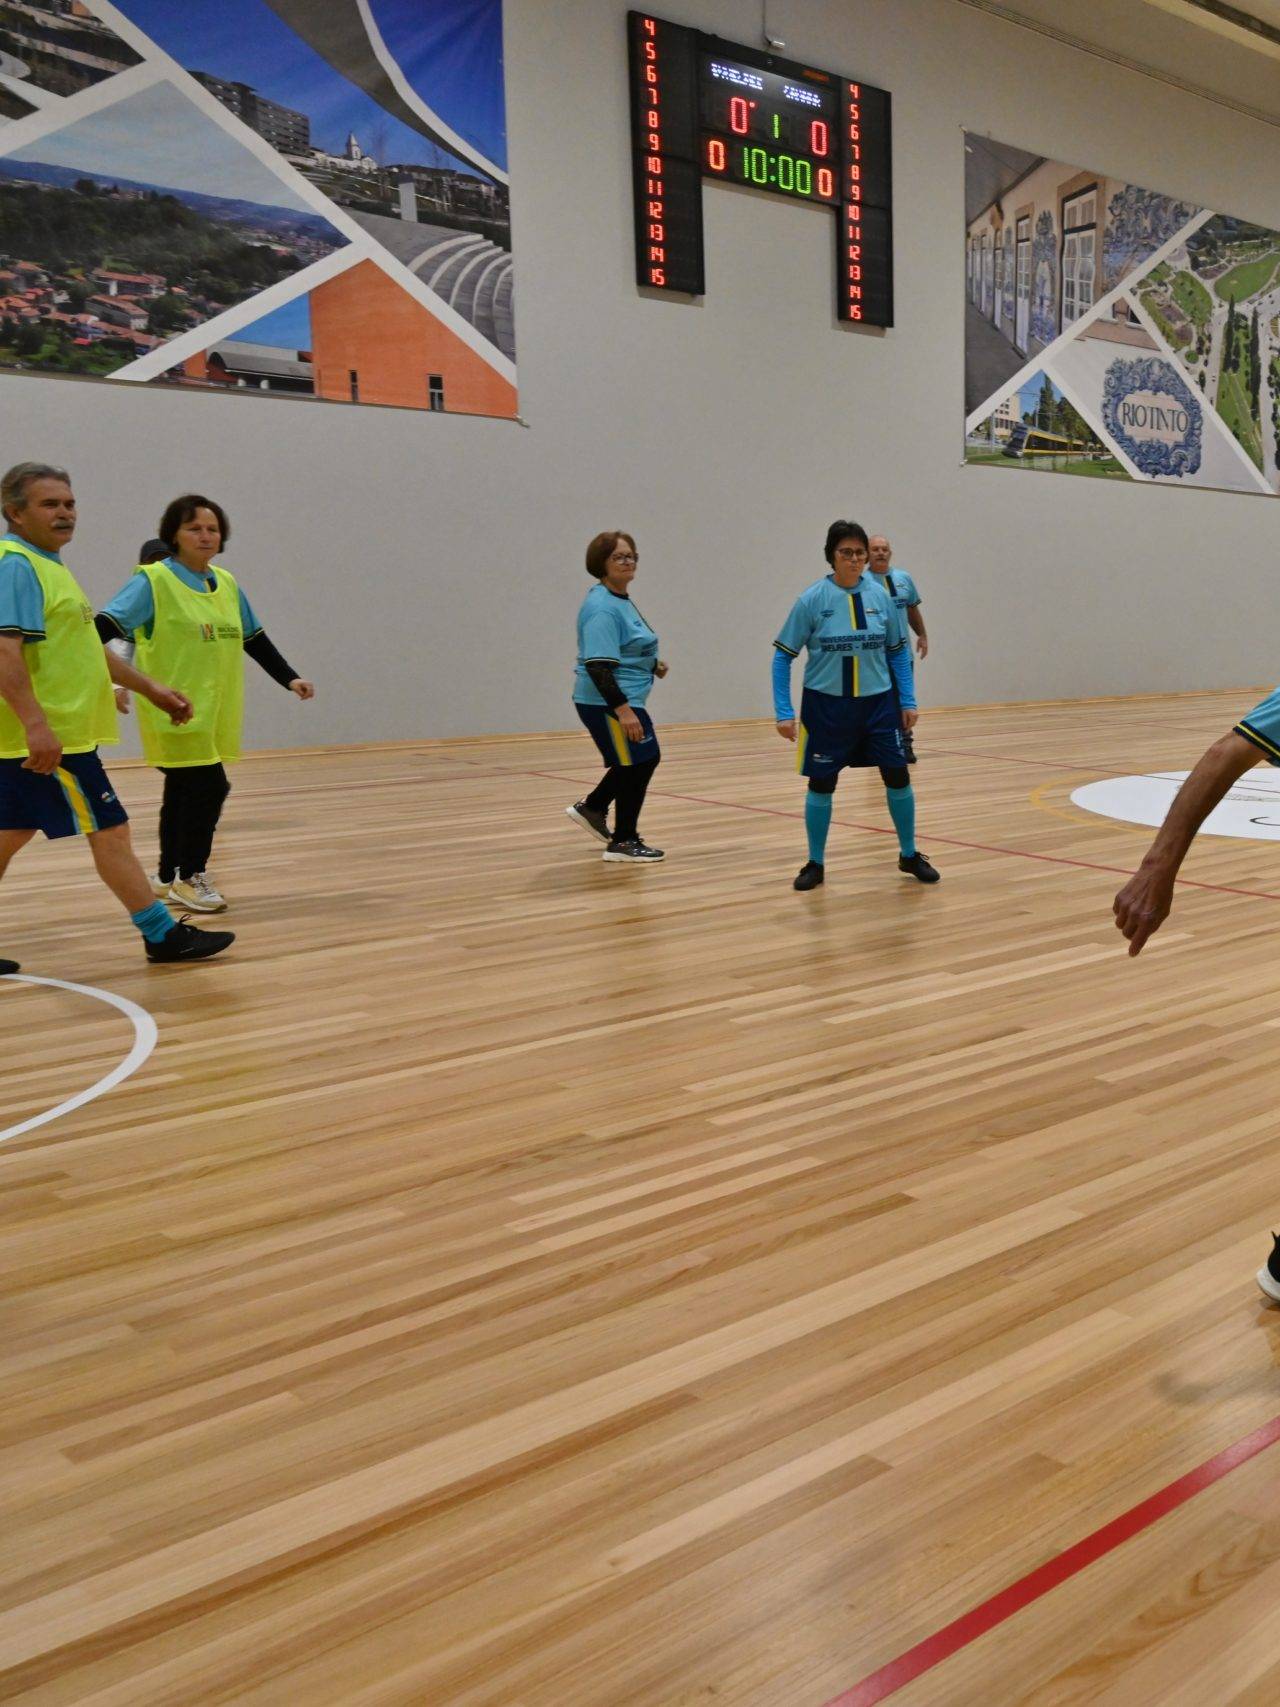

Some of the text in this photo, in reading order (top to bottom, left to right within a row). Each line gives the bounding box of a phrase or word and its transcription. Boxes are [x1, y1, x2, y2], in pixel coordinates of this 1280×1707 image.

[645, 19, 655, 36] 4
[645, 42, 656, 60] 5
[646, 65, 657, 83] 6
[648, 88, 658, 104] 7
[849, 84, 859, 99] 4
[648, 111, 658, 128] 8
[730, 96, 748, 134] 0
[850, 104, 859, 120] 5
[773, 114, 779, 139] 1
[850, 124, 859, 140] 6
[649, 133, 659, 150] 9
[811, 120, 827, 156] 0
[708, 140, 725, 170] 0
[851, 145, 860, 160] 7
[648, 157, 661, 174] 10
[743, 147, 811, 195] 10:00
[851, 165, 860, 180] 8
[649, 180, 662, 195] 11
[818, 168, 833, 197] 0
[851, 185, 860, 200] 9
[649, 202, 662, 219] 12
[848, 205, 860, 221] 10
[650, 224, 663, 241] 13
[848, 225, 860, 240] 11
[650, 246, 664, 262] 14
[651, 268, 665, 285] 15
